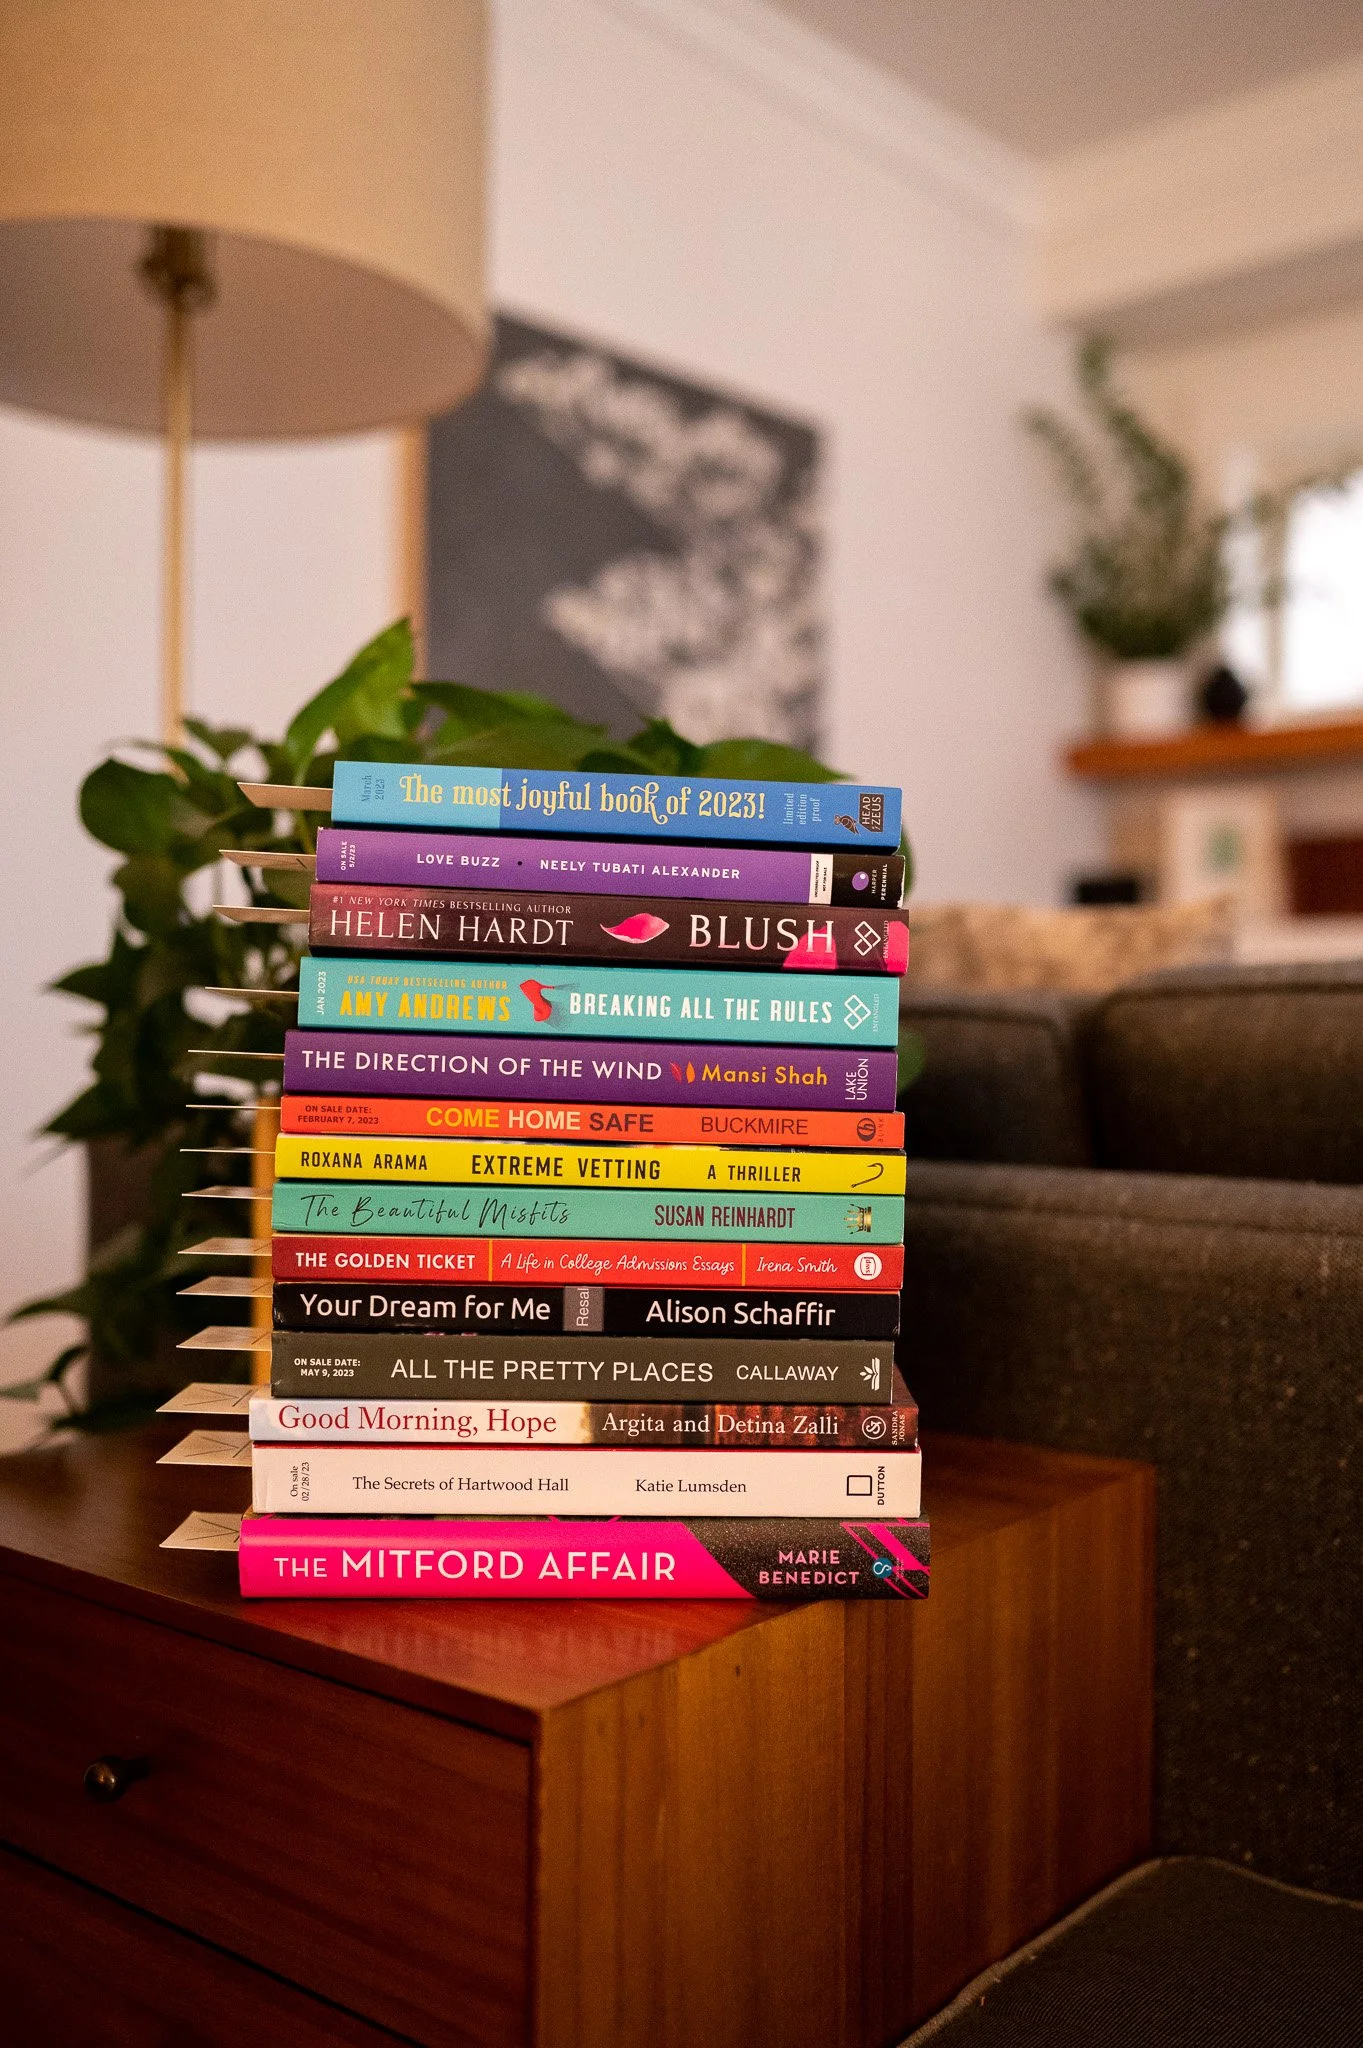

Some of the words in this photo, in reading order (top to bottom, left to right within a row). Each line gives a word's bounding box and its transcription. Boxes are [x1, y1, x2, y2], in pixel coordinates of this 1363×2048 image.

[400, 773, 443, 803] The
[453, 781, 511, 807] most
[516, 778, 591, 815] joyful
[600, 782, 668, 825] book
[667, 787, 691, 815] of
[699, 790, 765, 819] 2023!
[783, 793, 794, 825] limited
[812, 797, 820, 822] proof
[862, 796, 871, 825] HEAD
[340, 860, 347, 871] ON
[417, 854, 454, 865] LOVE
[461, 856, 500, 868] BUZZ
[540, 860, 586, 872] NEELY
[593, 862, 645, 875] TUBATI
[652, 865, 740, 879] ALEXANDER
[333, 896, 343, 904] #1
[349, 897, 372, 905] NEW
[379, 897, 407, 907] YORK
[413, 899, 445, 909] TIMES
[450, 900, 521, 912] BESTSELLING
[526, 904, 571, 914] AUTHOR
[330, 910, 441, 940] HELEN
[459, 915, 574, 946] HARDT
[689, 914, 834, 953] BLUSH
[318, 971, 326, 996] 2023
[348, 976, 365, 984] USA
[403, 977, 466, 988] BESTSELLING
[317, 997, 325, 1015] JAN
[340, 991, 388, 1016] AMY
[398, 993, 511, 1021] ANDREWS
[569, 992, 671, 1018] BREAKING
[680, 996, 714, 1020] ALL
[724, 998, 760, 1021] THE
[770, 999, 833, 1024] RULES
[302, 1050, 345, 1069] THE
[355, 1052, 488, 1075] DIRECTION
[498, 1057, 531, 1075] OF
[540, 1058, 582, 1078] THE
[592, 1060, 662, 1080] WIND
[701, 1063, 767, 1083] Mansi
[775, 1065, 827, 1086] Shah
[845, 1071, 857, 1100] LAKE
[857, 1058, 869, 1100] UNION
[297, 1115, 345, 1124] FEBRUARY
[348, 1117, 355, 1126] 7,
[357, 1117, 379, 1125] 2023
[305, 1105, 319, 1113] ON
[320, 1105, 343, 1114] SALE
[345, 1106, 372, 1114] DATE:
[426, 1107, 500, 1128] COME
[508, 1109, 580, 1130] HOME
[589, 1112, 654, 1133] SAFE
[701, 1116, 809, 1135] BUCKMIRE
[301, 1151, 363, 1169] ROXANA
[373, 1153, 427, 1170] ARAMA
[471, 1155, 564, 1177] EXTREME
[578, 1158, 660, 1180] VETTING
[707, 1165, 716, 1180] A
[728, 1165, 801, 1182] THRILLER
[300, 1194, 340, 1227] The
[350, 1196, 470, 1227] Beautiful
[479, 1198, 571, 1230] Misfits
[655, 1205, 704, 1227] SUSAN
[711, 1206, 795, 1229] REINHARDT
[295, 1252, 327, 1267] THE
[335, 1253, 410, 1269] GOLDEN
[417, 1254, 475, 1270] TICKET
[500, 1253, 512, 1269] A
[516, 1254, 541, 1274] Life
[543, 1256, 554, 1269] in
[559, 1254, 612, 1276] College
[616, 1255, 688, 1271] Admissions
[692, 1255, 735, 1275] Essays
[756, 1256, 793, 1273] Irena
[797, 1257, 838, 1274] Smith
[300, 1293, 362, 1317] Your
[370, 1295, 456, 1318] Dream
[465, 1294, 504, 1319] for
[511, 1298, 550, 1321] Me
[645, 1299, 726, 1325] Alison
[733, 1301, 835, 1326] Schaffir
[294, 1358, 308, 1366] ON
[310, 1358, 332, 1367] SALE
[334, 1358, 361, 1367] DATE:
[300, 1368, 320, 1377] MAY
[322, 1368, 331, 1379] 9,
[333, 1368, 354, 1378] 2023
[391, 1358, 436, 1379] ALL
[444, 1359, 494, 1380] THE
[504, 1360, 604, 1381] PRETTY
[613, 1362, 713, 1382] PLACES
[736, 1365, 839, 1382] CALLAWAY
[278, 1405, 349, 1430] Good
[358, 1407, 478, 1439] Morning,
[487, 1409, 557, 1439] Hope
[602, 1413, 665, 1436] Argita
[673, 1414, 710, 1433] and
[718, 1414, 785, 1434] Detina
[793, 1415, 838, 1435] Zalli
[290, 1484, 298, 1497] On
[353, 1476, 380, 1490] The
[384, 1477, 435, 1491] Secrets
[439, 1477, 454, 1491] of
[458, 1478, 533, 1492] Hartwood
[538, 1478, 569, 1491] Hall
[635, 1479, 674, 1493] Katie
[678, 1479, 747, 1493] Lumsden
[877, 1465, 885, 1506] DUTTON
[273, 1557, 327, 1577] THE
[342, 1550, 524, 1579] MITFORD
[538, 1551, 676, 1581] AFFAIR
[778, 1550, 840, 1565] MARIE
[759, 1570, 860, 1585] BENEDICT
